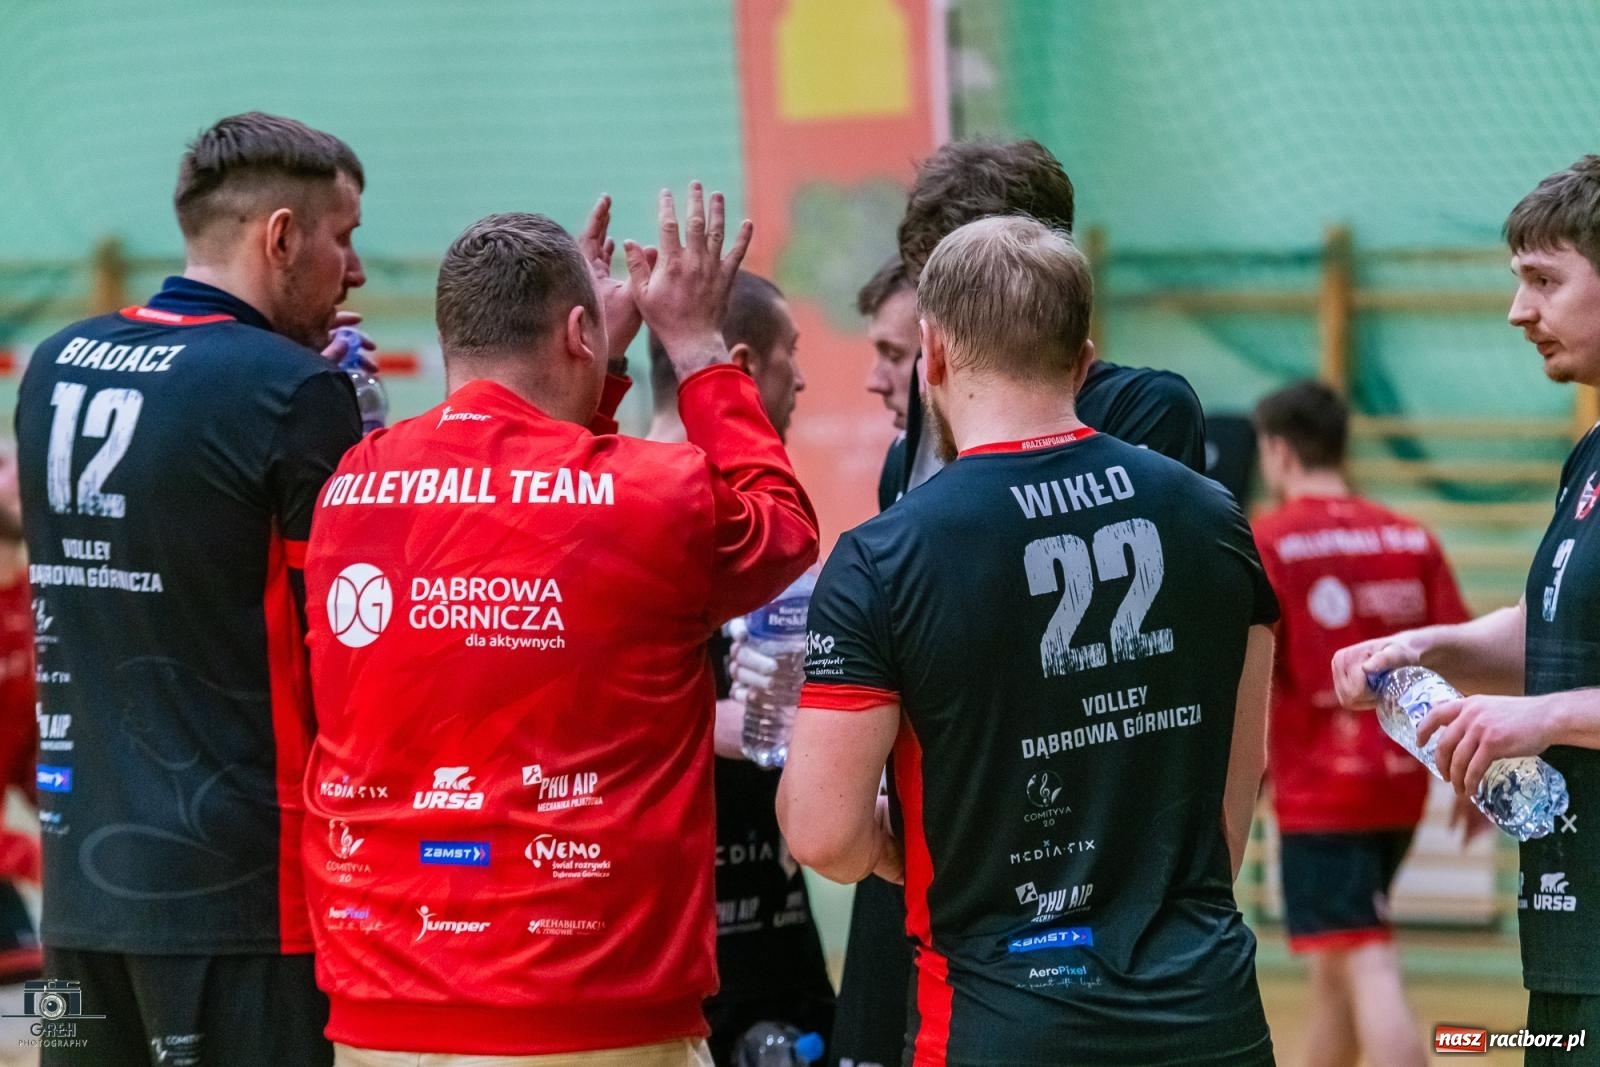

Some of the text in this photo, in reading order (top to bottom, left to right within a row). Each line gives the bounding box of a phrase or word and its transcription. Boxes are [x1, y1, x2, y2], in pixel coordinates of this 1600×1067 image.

[55, 337, 187, 372] BIADACZ
[47, 381, 144, 518] 12
[322, 467, 615, 508] VOLLEYBALL TEAM
[1010, 465, 1136, 519] WIKŁO
[62, 538, 111, 561] VOLLEY
[87, 564, 163, 592] GÓRNICZA
[410, 577, 564, 603] DĄBROWA
[1023, 517, 1174, 678] 22
[408, 600, 565, 631] GÓRNICZA
[465, 633, 566, 650] dla aktywnych
[1082, 685, 1149, 717] VOLLEY
[1021, 704, 1202, 759] DĄBROWA GÓRNICZA
[539, 772, 599, 800] PHU AIP
[1024, 806, 1072, 823] COMITYVA
[536, 838, 601, 860] NEMO
[1036, 883, 1094, 916] PHU AIP
[1029, 965, 1087, 979] AeroPixel
